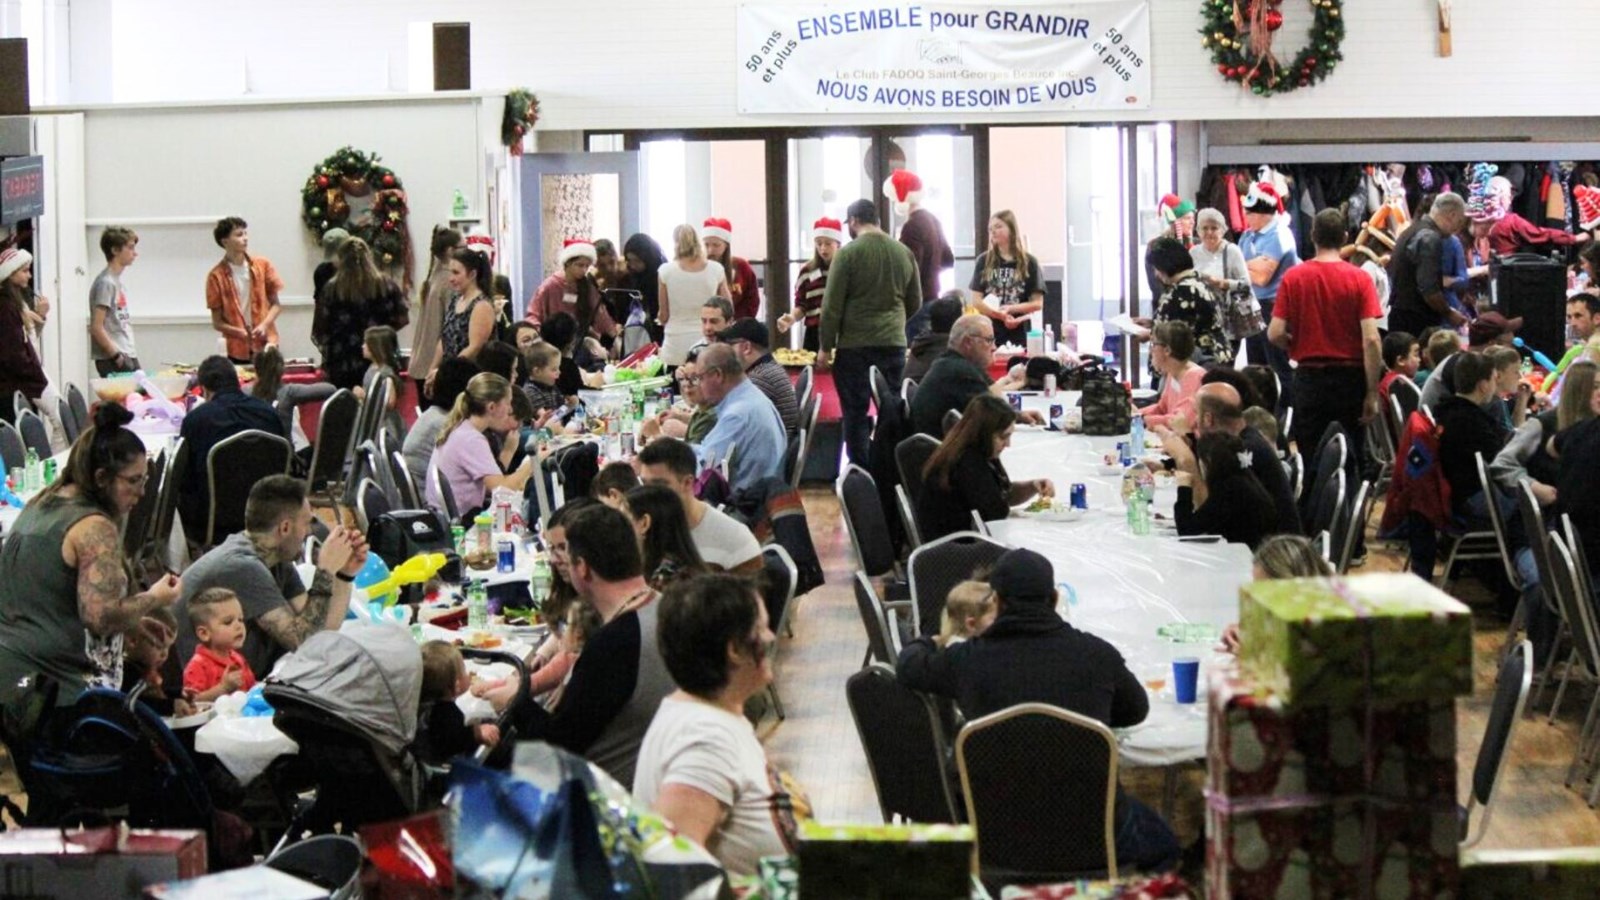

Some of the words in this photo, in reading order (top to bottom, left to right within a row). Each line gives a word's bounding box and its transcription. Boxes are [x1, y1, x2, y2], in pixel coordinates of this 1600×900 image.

[798, 6, 922, 41] ENSEMBLE
[930, 12, 979, 32] pour
[985, 10, 1089, 39] GRANDIR
[745, 54, 763, 73] 50
[761, 30, 782, 55] ans
[762, 67, 776, 84] et
[774, 38, 798, 70] plus
[1093, 41, 1107, 55] et
[1103, 53, 1132, 82] plus
[1105, 27, 1123, 45] 50
[1120, 45, 1144, 68] ans
[816, 79, 868, 102] NOUS
[873, 87, 936, 107] AVONS
[942, 88, 1010, 107] BESOIN
[1017, 86, 1041, 104] DE
[1045, 76, 1097, 100] VOUS
[882, 69, 925, 79] FADOQ
